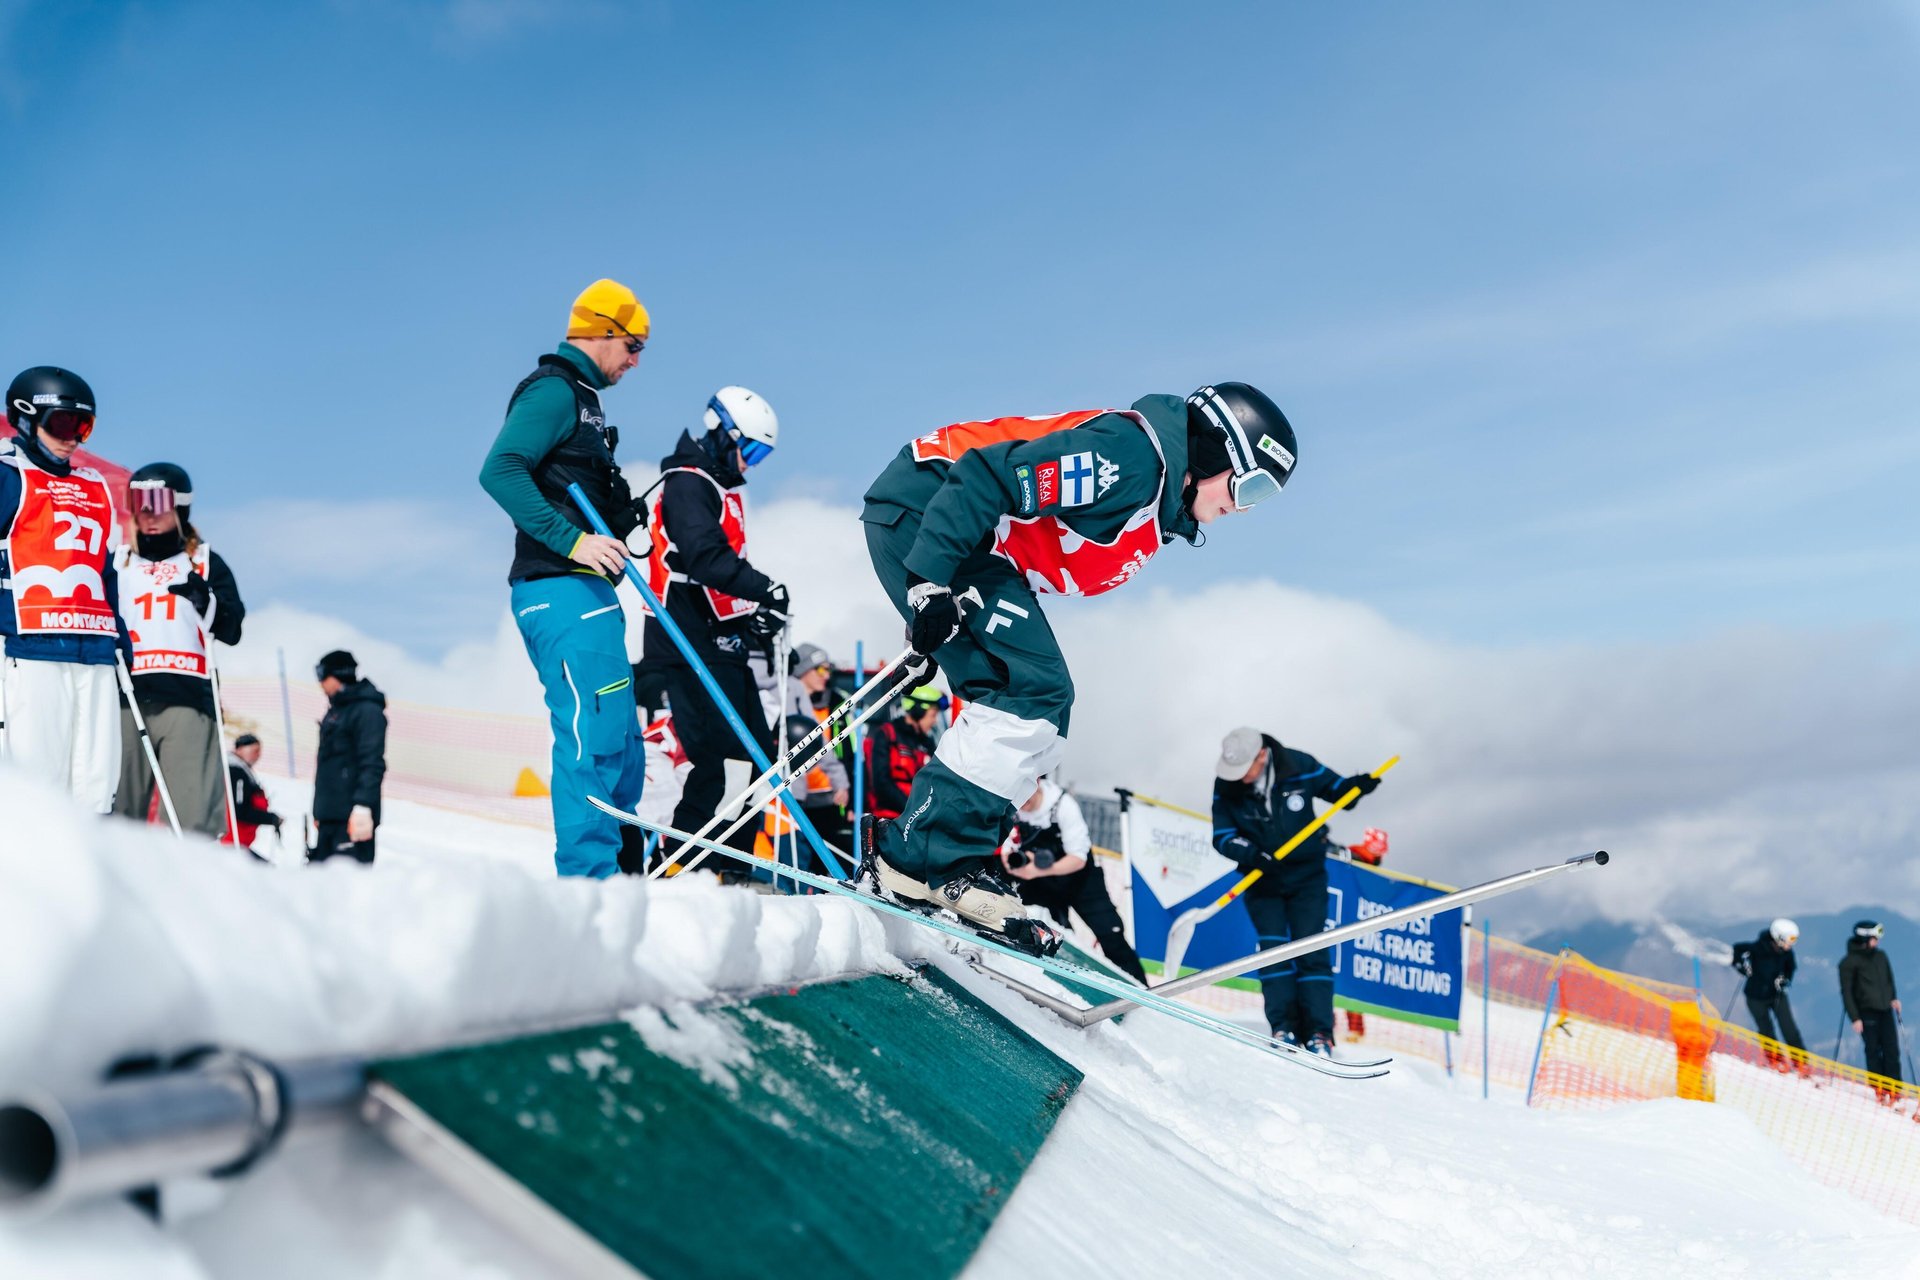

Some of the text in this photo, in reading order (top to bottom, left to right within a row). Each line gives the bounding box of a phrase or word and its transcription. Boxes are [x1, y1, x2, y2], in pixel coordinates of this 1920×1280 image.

[53, 511, 104, 556] 27
[134, 592, 177, 620] 11
[133, 653, 199, 671] NTAFON
[786, 699, 854, 761] ZIPLINE
[973, 903, 997, 918] K2
[1384, 933, 1436, 965] FRAGE
[1353, 953, 1451, 997] DER HALTUNG
